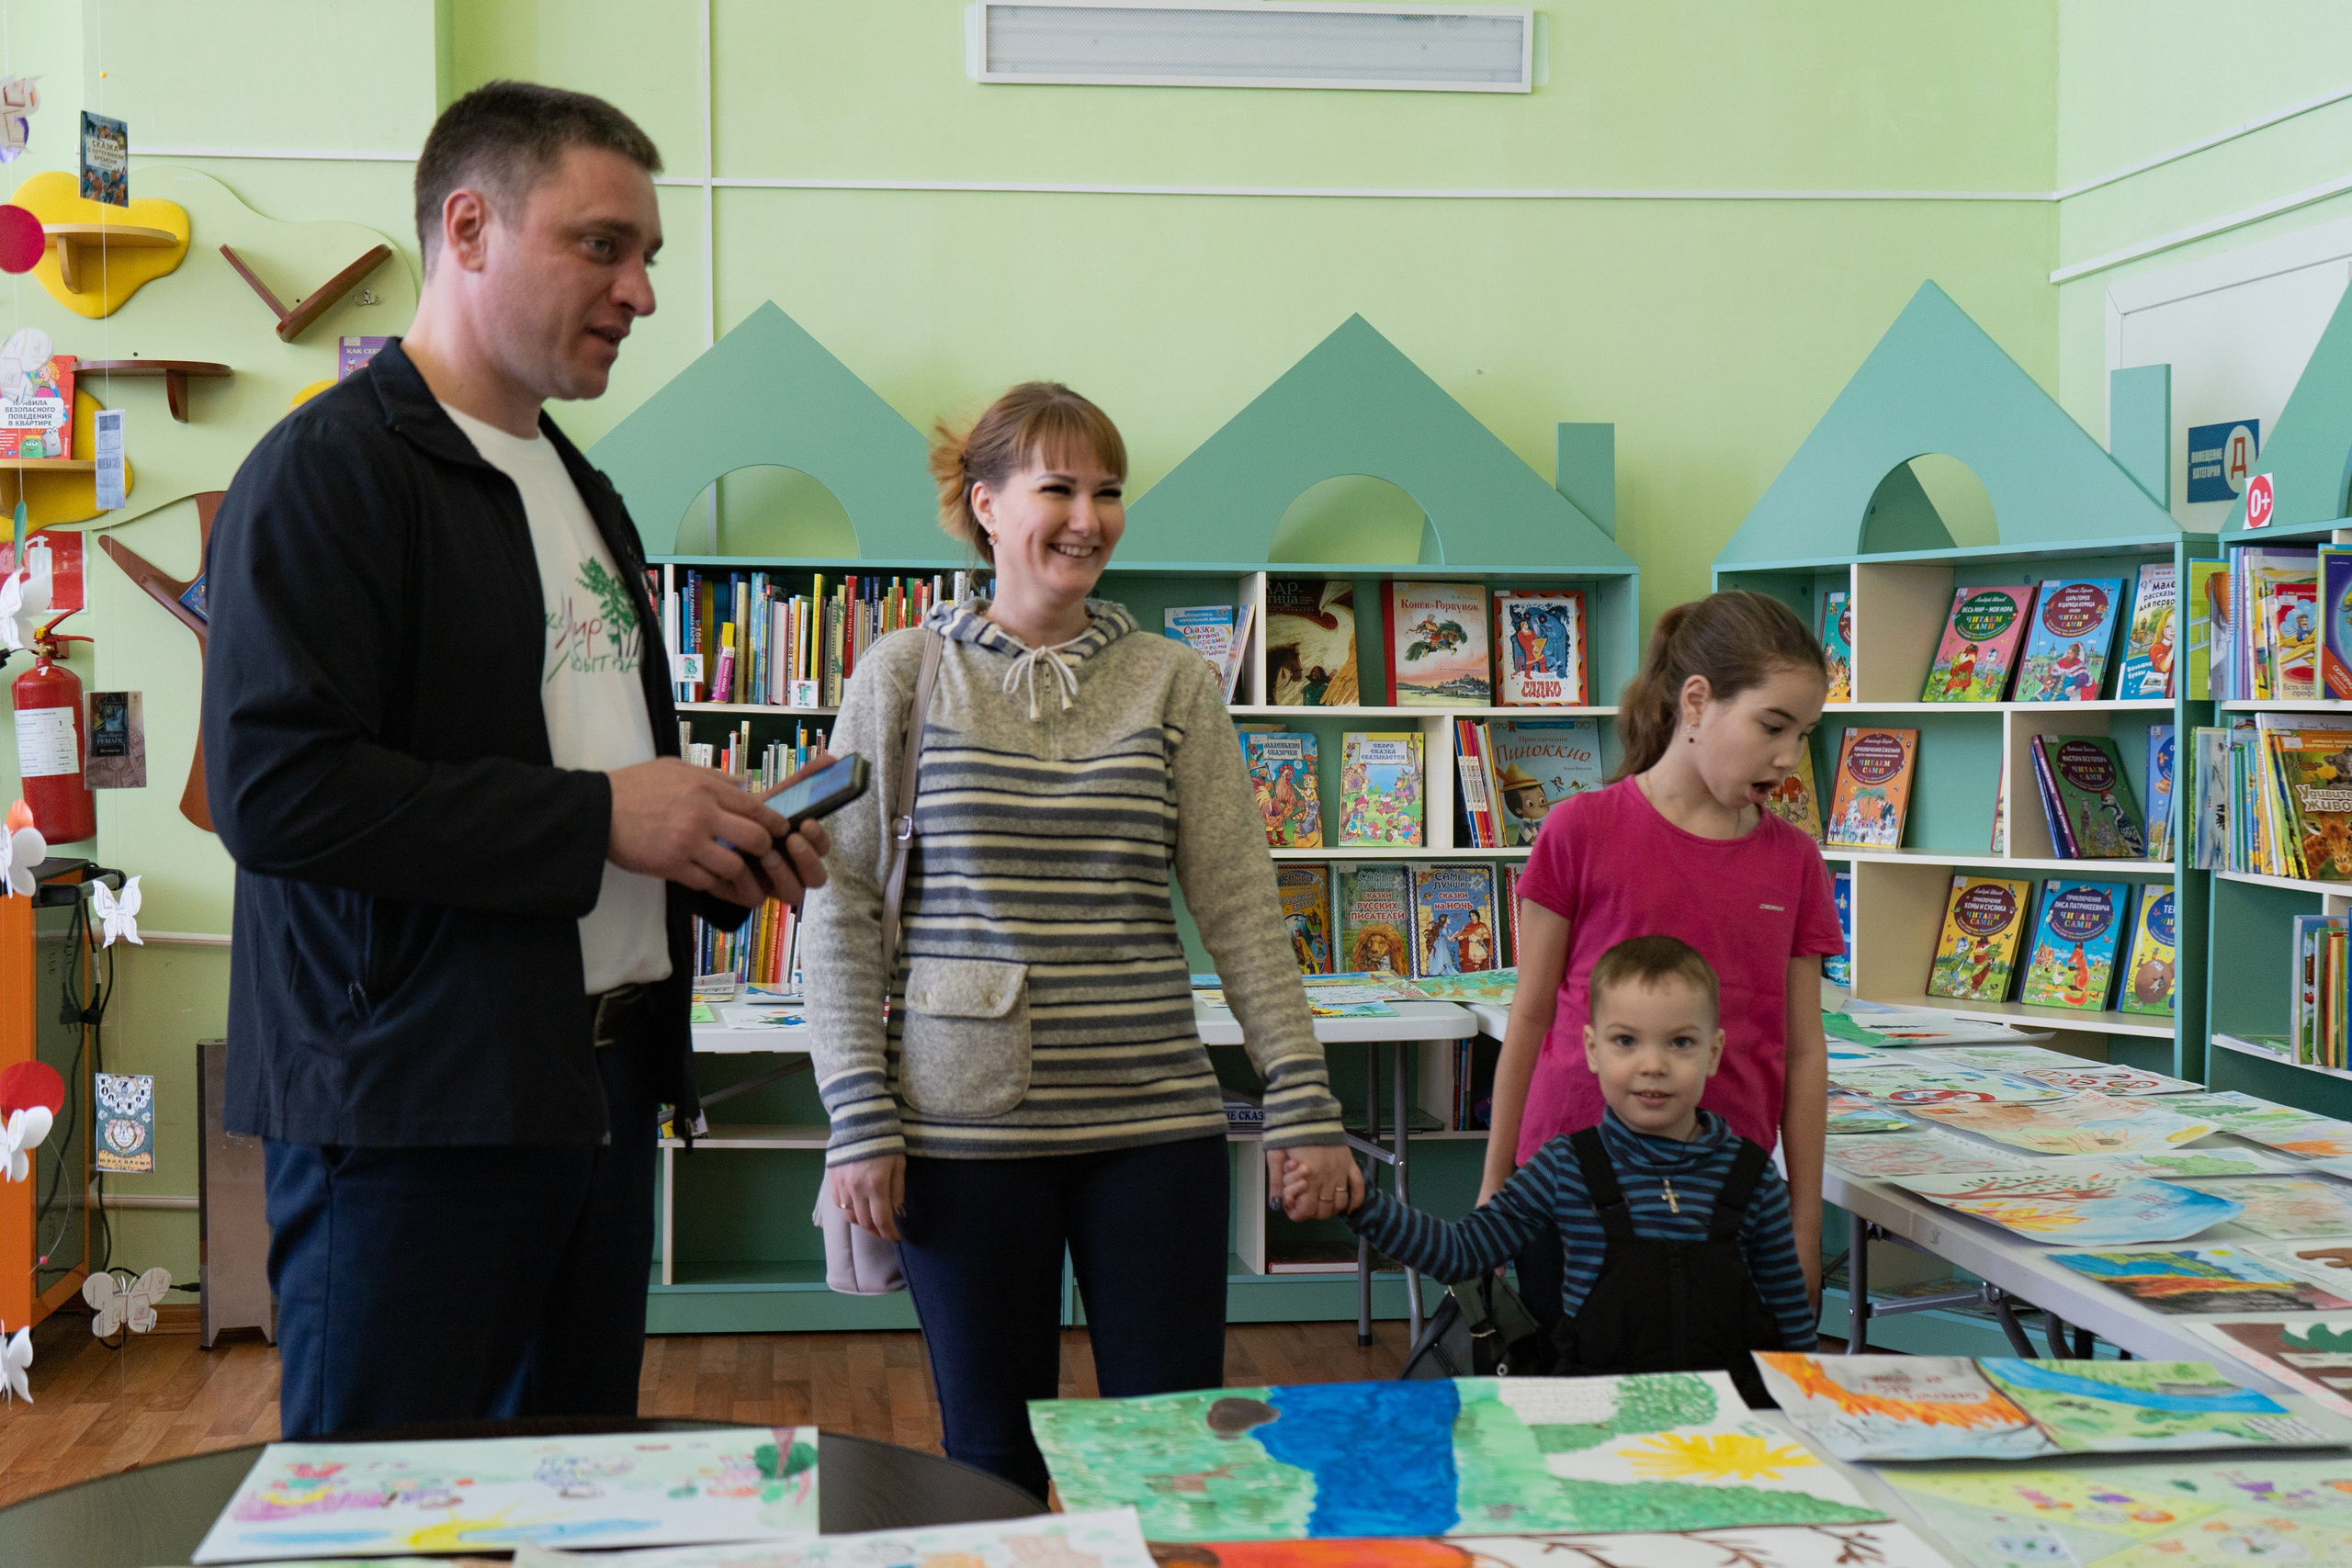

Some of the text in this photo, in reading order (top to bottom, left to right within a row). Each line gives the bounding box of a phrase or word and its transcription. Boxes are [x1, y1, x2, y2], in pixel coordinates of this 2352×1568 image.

[92, 140, 119, 152] СКАЗКА
[2230, 436, 2246, 479] Д
[2250, 489, 2271, 517] 0+
[2152, 581, 2175, 592] Мале
[1268, 595, 1299, 607] тица
[2139, 598, 2175, 612] для перво
[1183, 626, 1216, 636] Сказка
[1193, 637, 1226, 647] царевне
[684, 660, 697, 675] В
[2126, 660, 2154, 672] Большие
[721, 660, 730, 693] МУМИ-ТРОЛЛЬ
[2127, 669, 2146, 680] буквы
[1521, 681, 1562, 698] САДКО
[1496, 743, 1591, 765] Пиноккио
[1859, 759, 1891, 767] ЧИТАЕМ
[2071, 765, 2105, 773] ЧИТАЕМ
[1281, 871, 1312, 882] САМЫЕ
[1358, 871, 1393, 882] САМЫЕ
[1434, 872, 1470, 882] САМЫЕ
[1357, 881, 1393, 890] ЛУЧШИЕ
[1433, 881, 1469, 890] ЛУЧШИЕ
[2065, 895, 2101, 903] ПРИКЛЮЧЕНИЯ
[1357, 902, 1398, 910] РУССКИХ
[1446, 901, 1474, 910] НОЧЬ
[2069, 902, 2109, 911] ПАТРИКЕЕВИЧА
[1350, 909, 1406, 920] ПИСАТЕЛЕЙ
[1966, 911, 2000, 920] ЧИТАЕМ
[2060, 911, 2099, 921] ЧИТАЕМ
[2064, 919, 2092, 929] САМИ
[2161, 917, 2174, 926] ЧИ
[1238, 1110, 1265, 1121] СКАЗ
